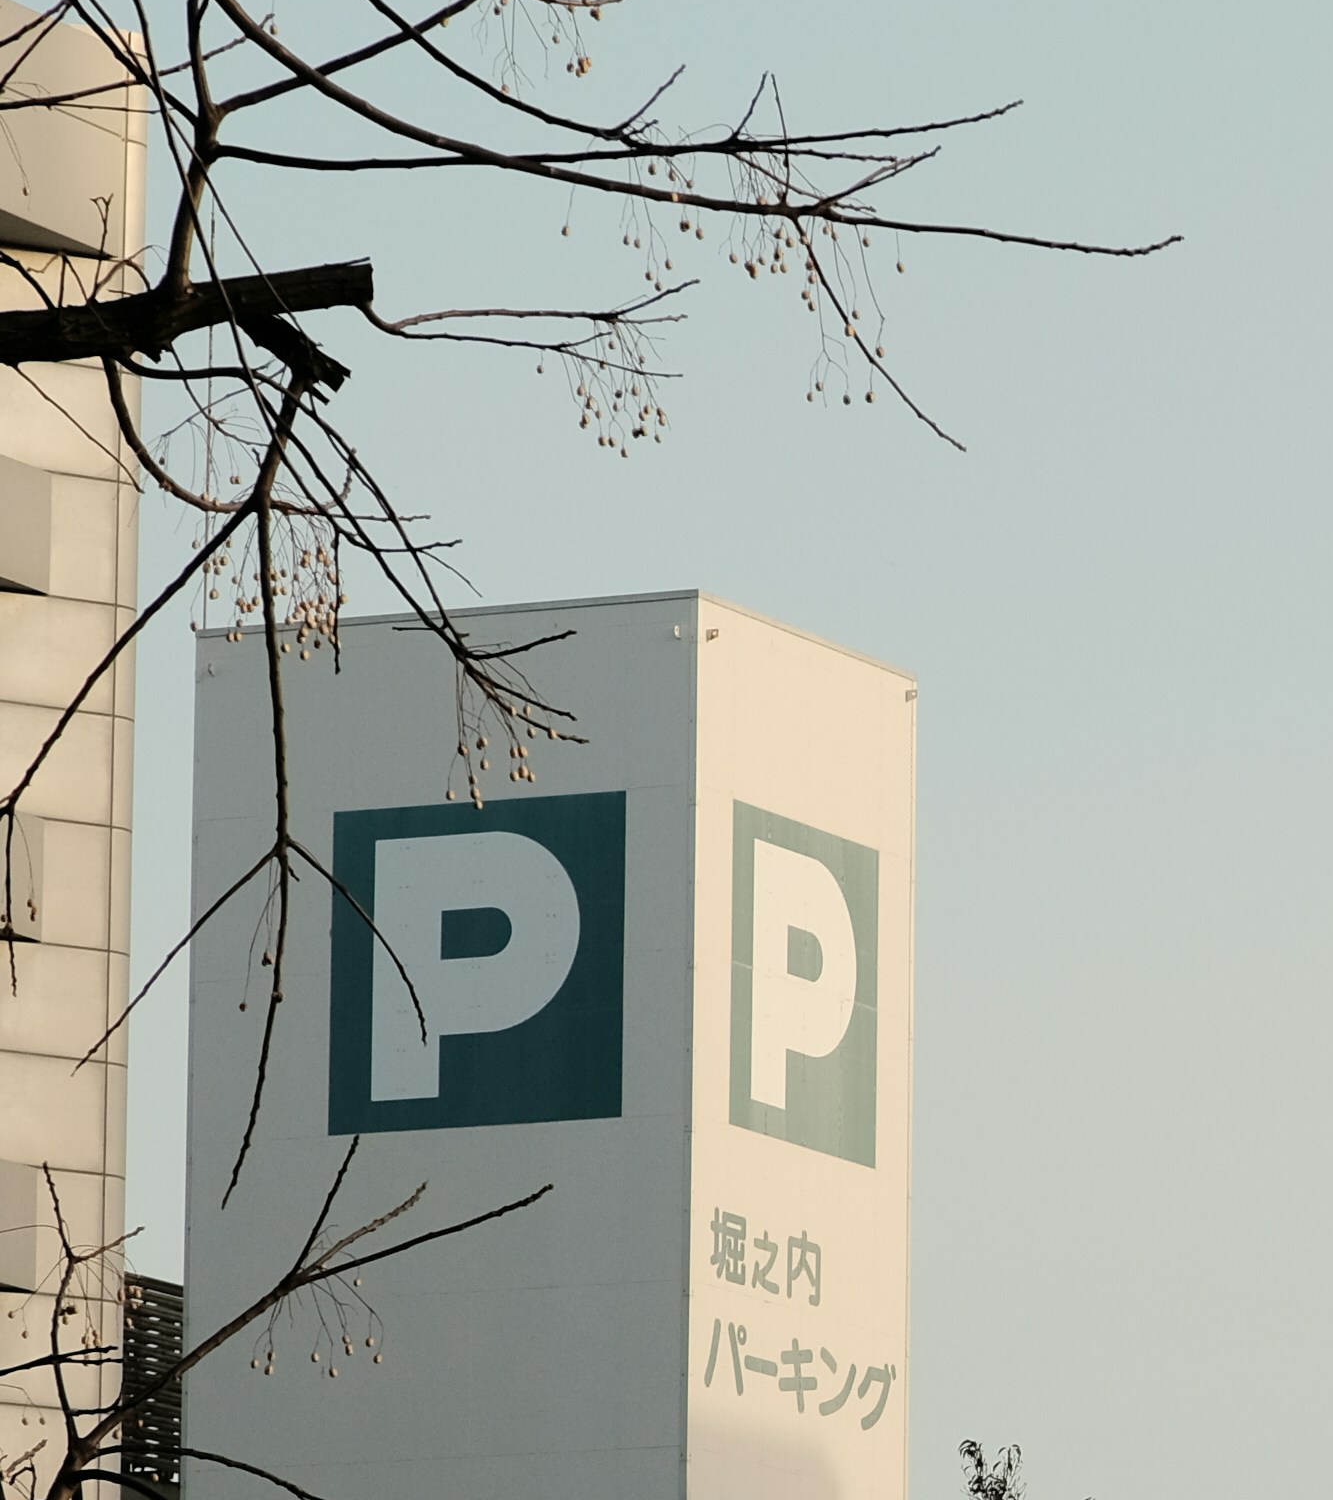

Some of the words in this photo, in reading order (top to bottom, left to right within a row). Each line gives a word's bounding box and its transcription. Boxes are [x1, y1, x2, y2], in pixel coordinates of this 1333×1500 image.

[370, 830, 580, 1102] P
[751, 838, 857, 1111] P
[709, 1206, 822, 1307] 堀之内
[703, 1318, 897, 1431] パーキング
